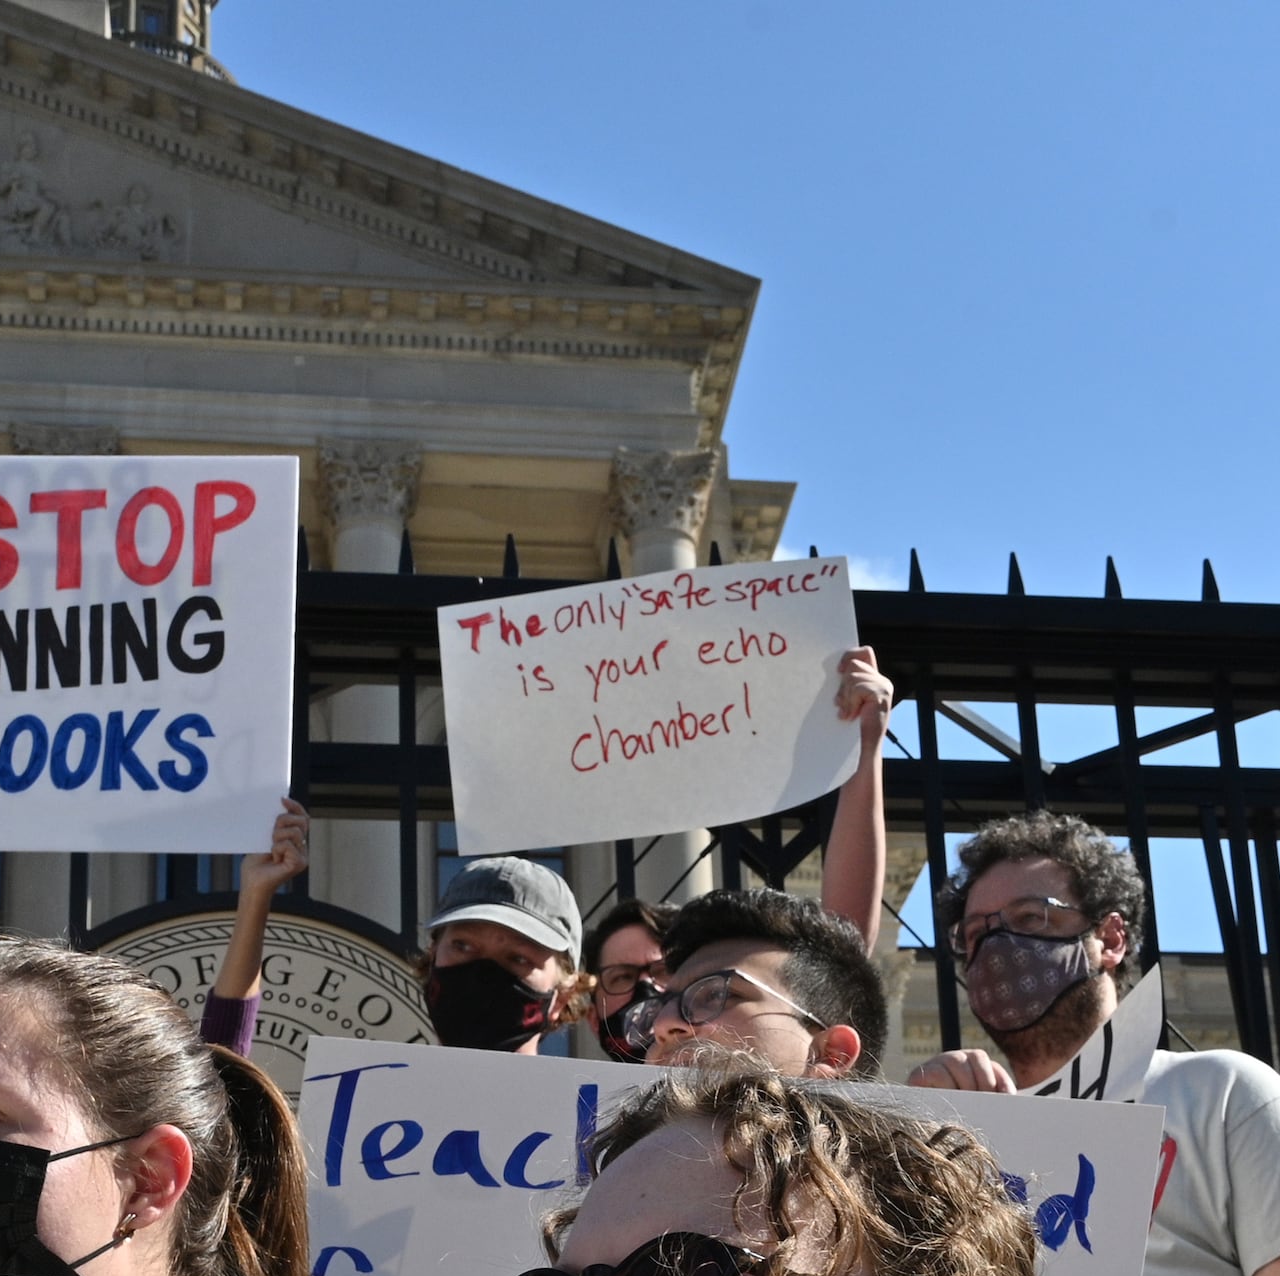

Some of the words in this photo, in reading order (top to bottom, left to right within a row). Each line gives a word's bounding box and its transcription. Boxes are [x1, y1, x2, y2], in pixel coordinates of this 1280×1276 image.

[458, 606, 548, 654] The
[554, 592, 626, 634] only
[516, 663, 555, 697] is
[584, 639, 669, 703] your
[697, 627, 787, 666] echo
[570, 681, 758, 773] chamber!
